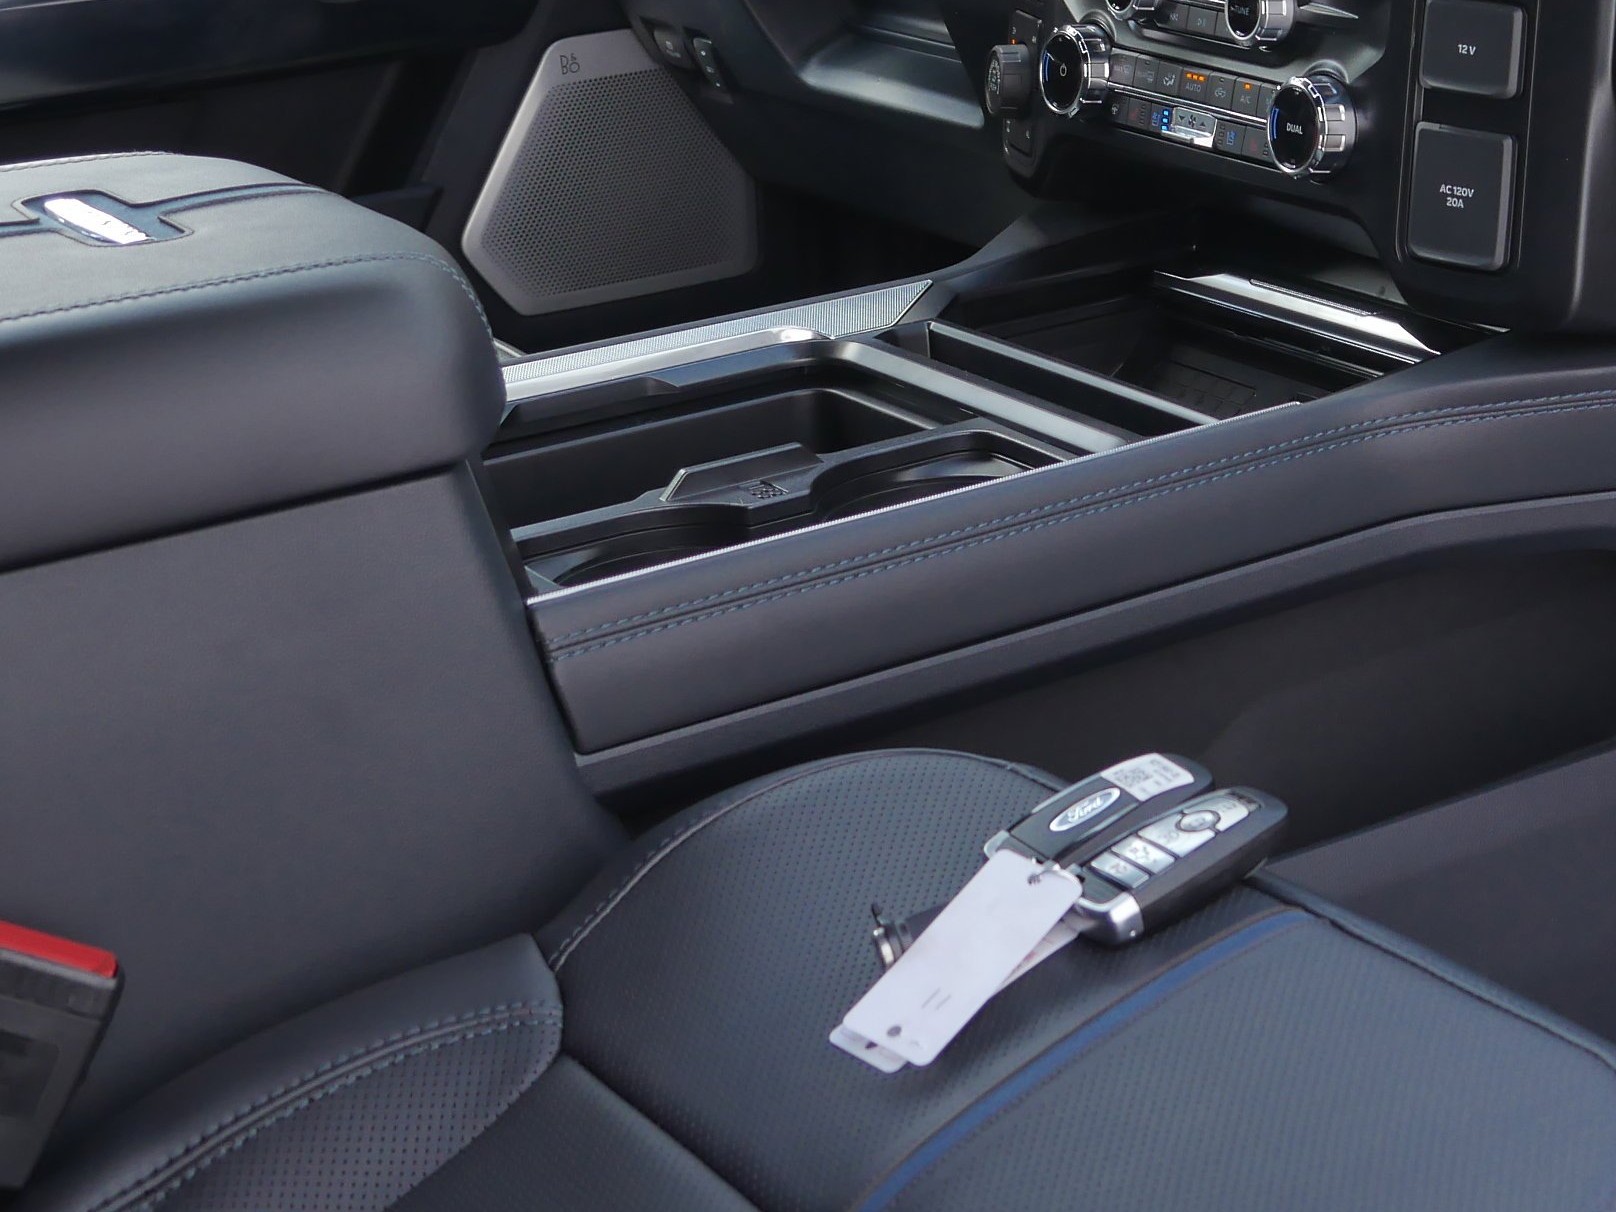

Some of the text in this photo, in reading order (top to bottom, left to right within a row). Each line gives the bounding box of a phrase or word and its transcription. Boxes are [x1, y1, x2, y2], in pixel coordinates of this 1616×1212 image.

[1185, 82, 1202, 93] AUTO
[1286, 122, 1303, 136] DUAL
[1439, 183, 1475, 199] AC 120V
[1446, 196, 1465, 209] 20A
